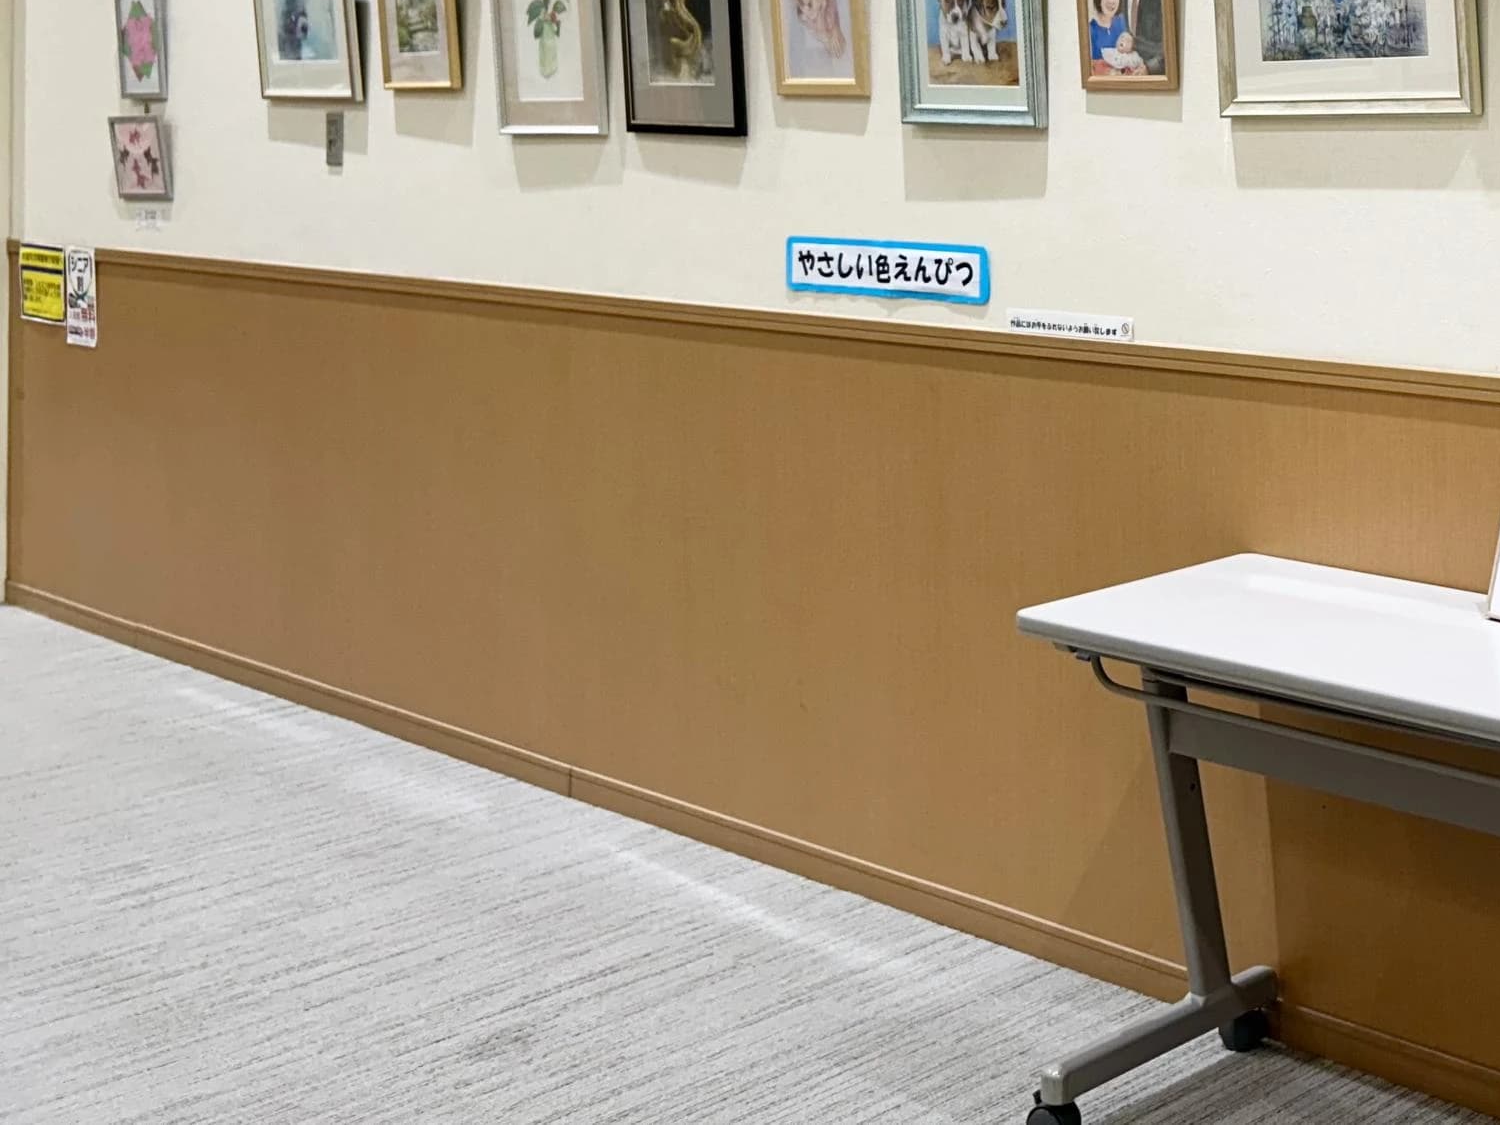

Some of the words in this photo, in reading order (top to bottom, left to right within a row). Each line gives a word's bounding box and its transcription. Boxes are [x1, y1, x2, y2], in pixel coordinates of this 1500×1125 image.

[797, 249, 975, 287] やさしい色えんぴつ
